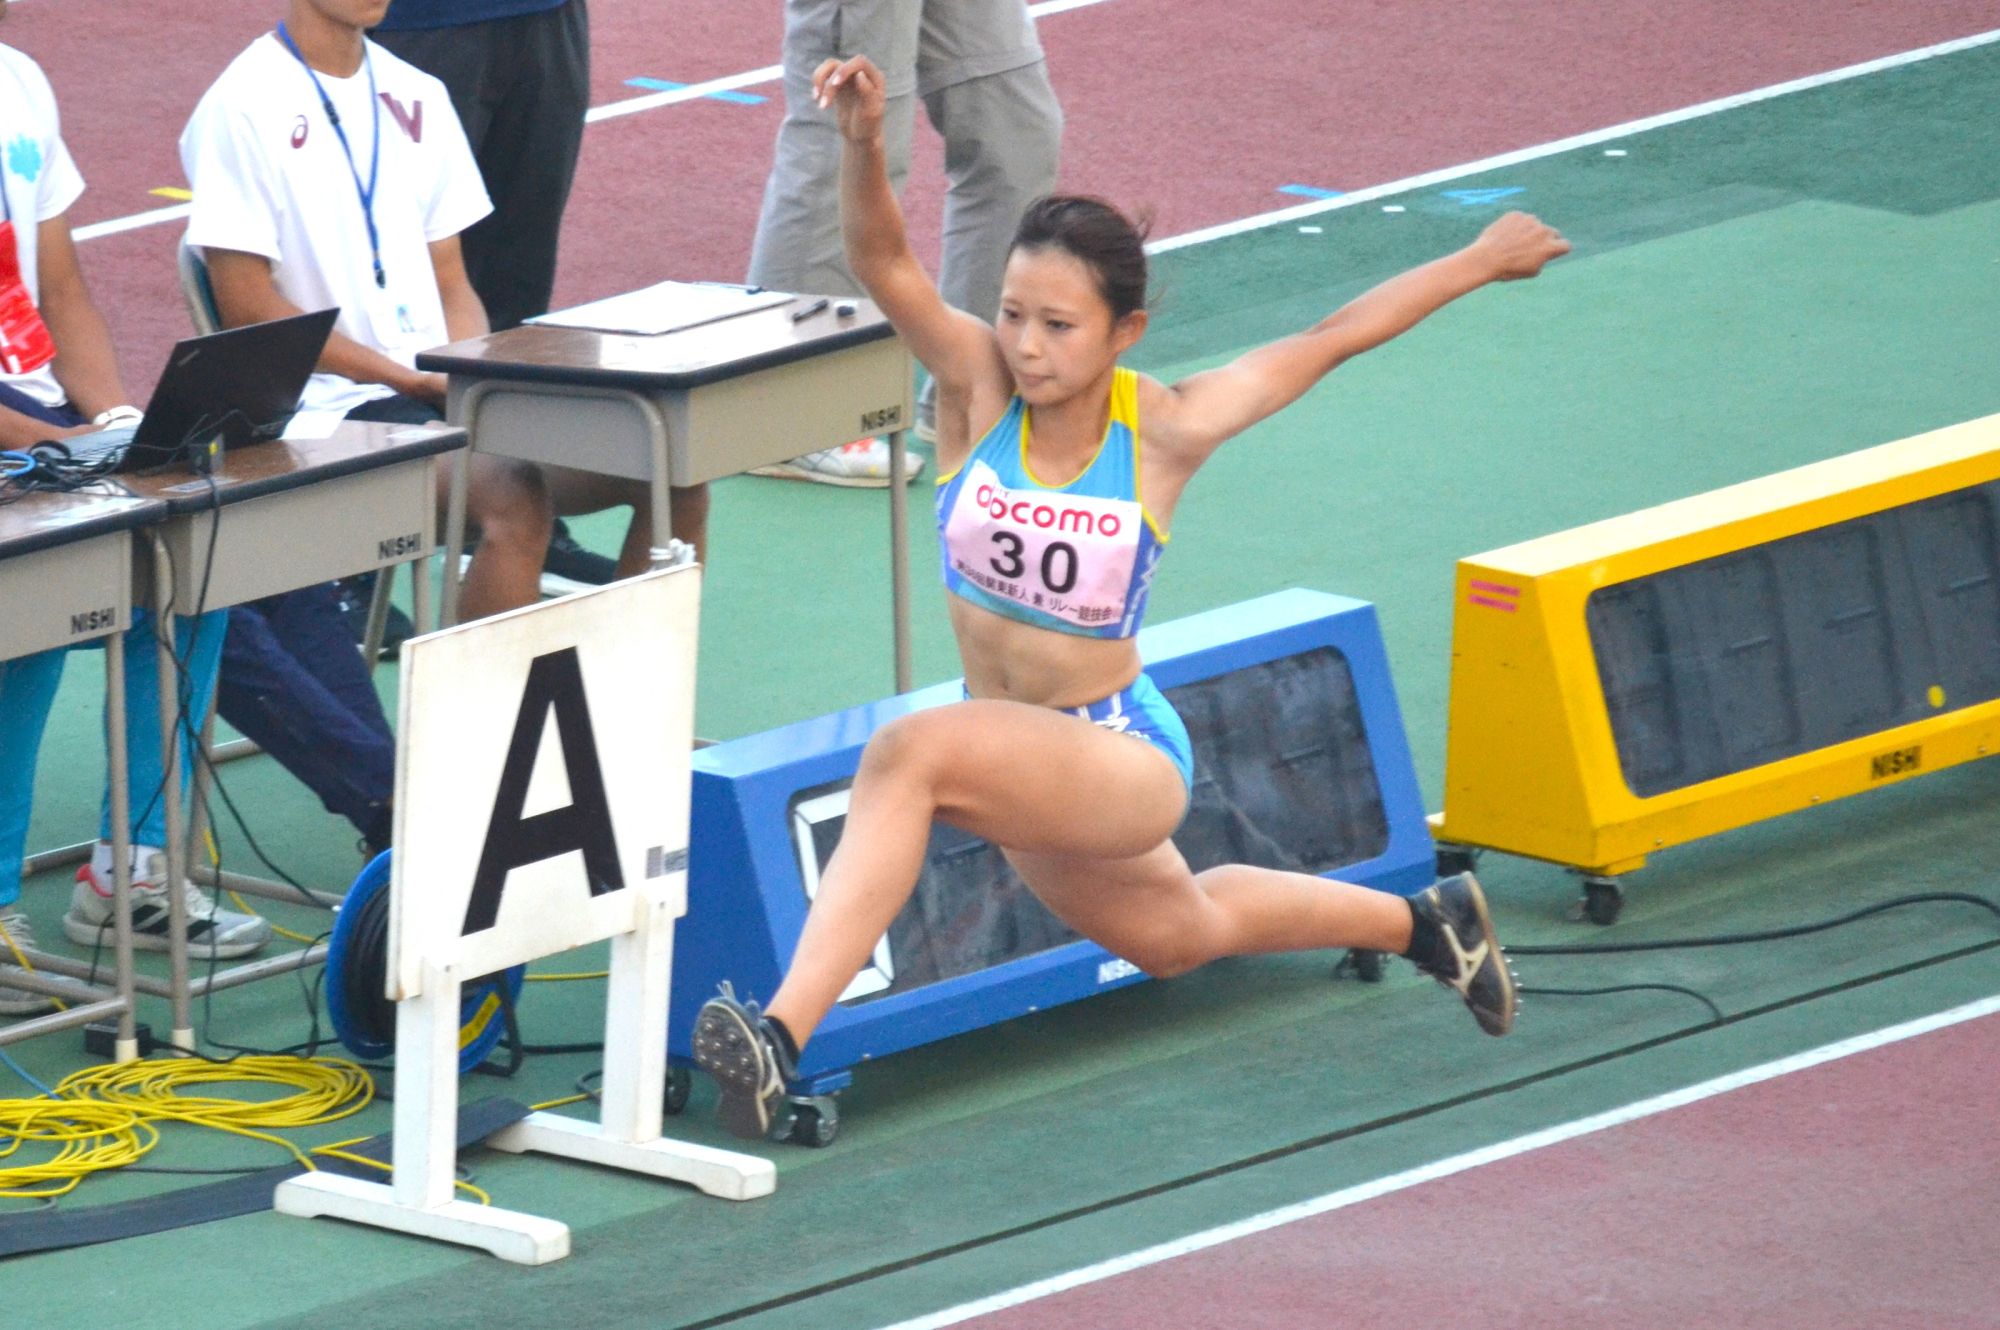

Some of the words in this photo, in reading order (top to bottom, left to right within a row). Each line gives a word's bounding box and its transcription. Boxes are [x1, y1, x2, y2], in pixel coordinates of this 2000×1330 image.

[861, 404, 901, 432] NISHI
[378, 532, 421, 560] NISHI
[989, 530, 1078, 594] 30
[71, 607, 115, 634] NISHI
[1872, 745, 1922, 780] NISHI
[460, 645, 626, 937] A
